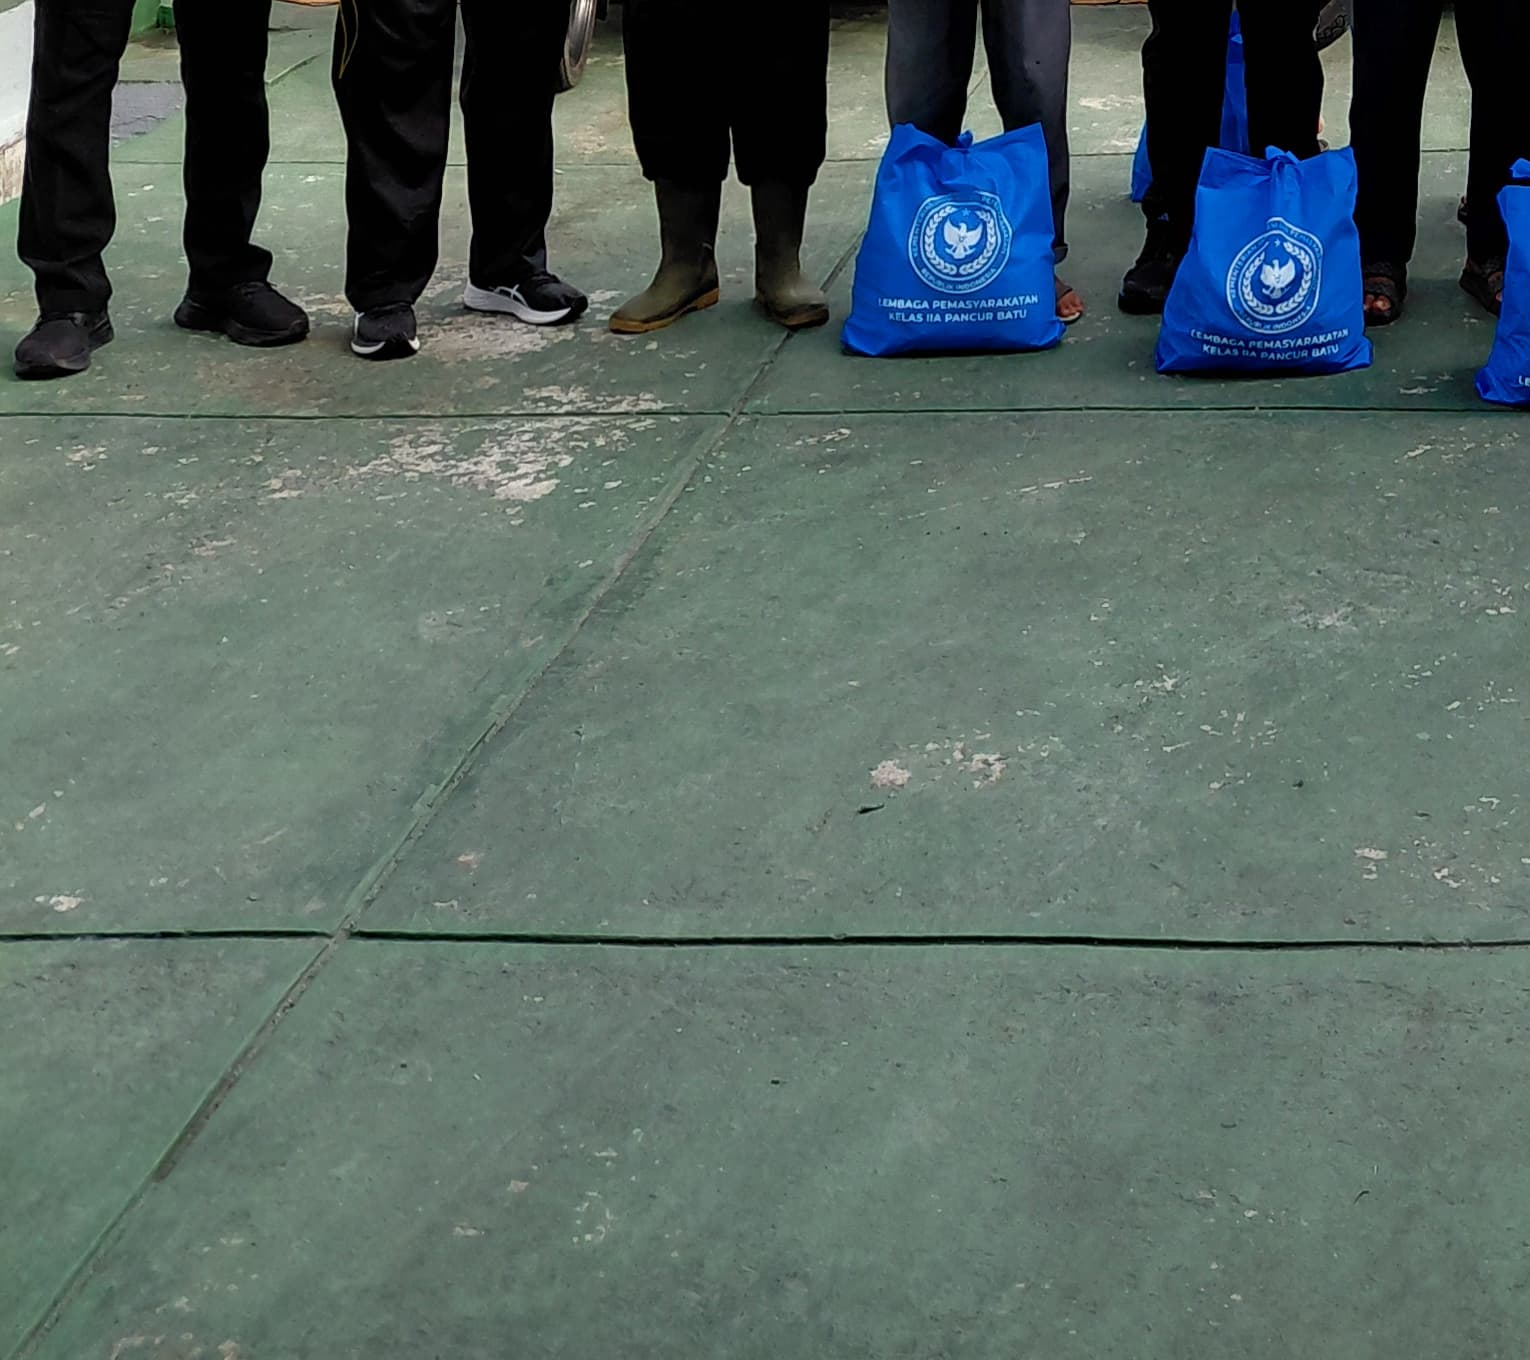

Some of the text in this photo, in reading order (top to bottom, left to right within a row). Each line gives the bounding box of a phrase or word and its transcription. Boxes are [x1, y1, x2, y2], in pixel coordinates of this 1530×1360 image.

[878, 294, 1039, 310] LEMBAGA PEMASYARAKATAN
[889, 310, 1028, 323] KELAS IIA PANCUR BATU
[1190, 328, 1350, 348] LEMBAGA PEMASYARAKATAN
[1203, 344, 1239, 357] KELAS
[1260, 348, 1308, 361] PANCUR
[1311, 344, 1340, 358] BATU
